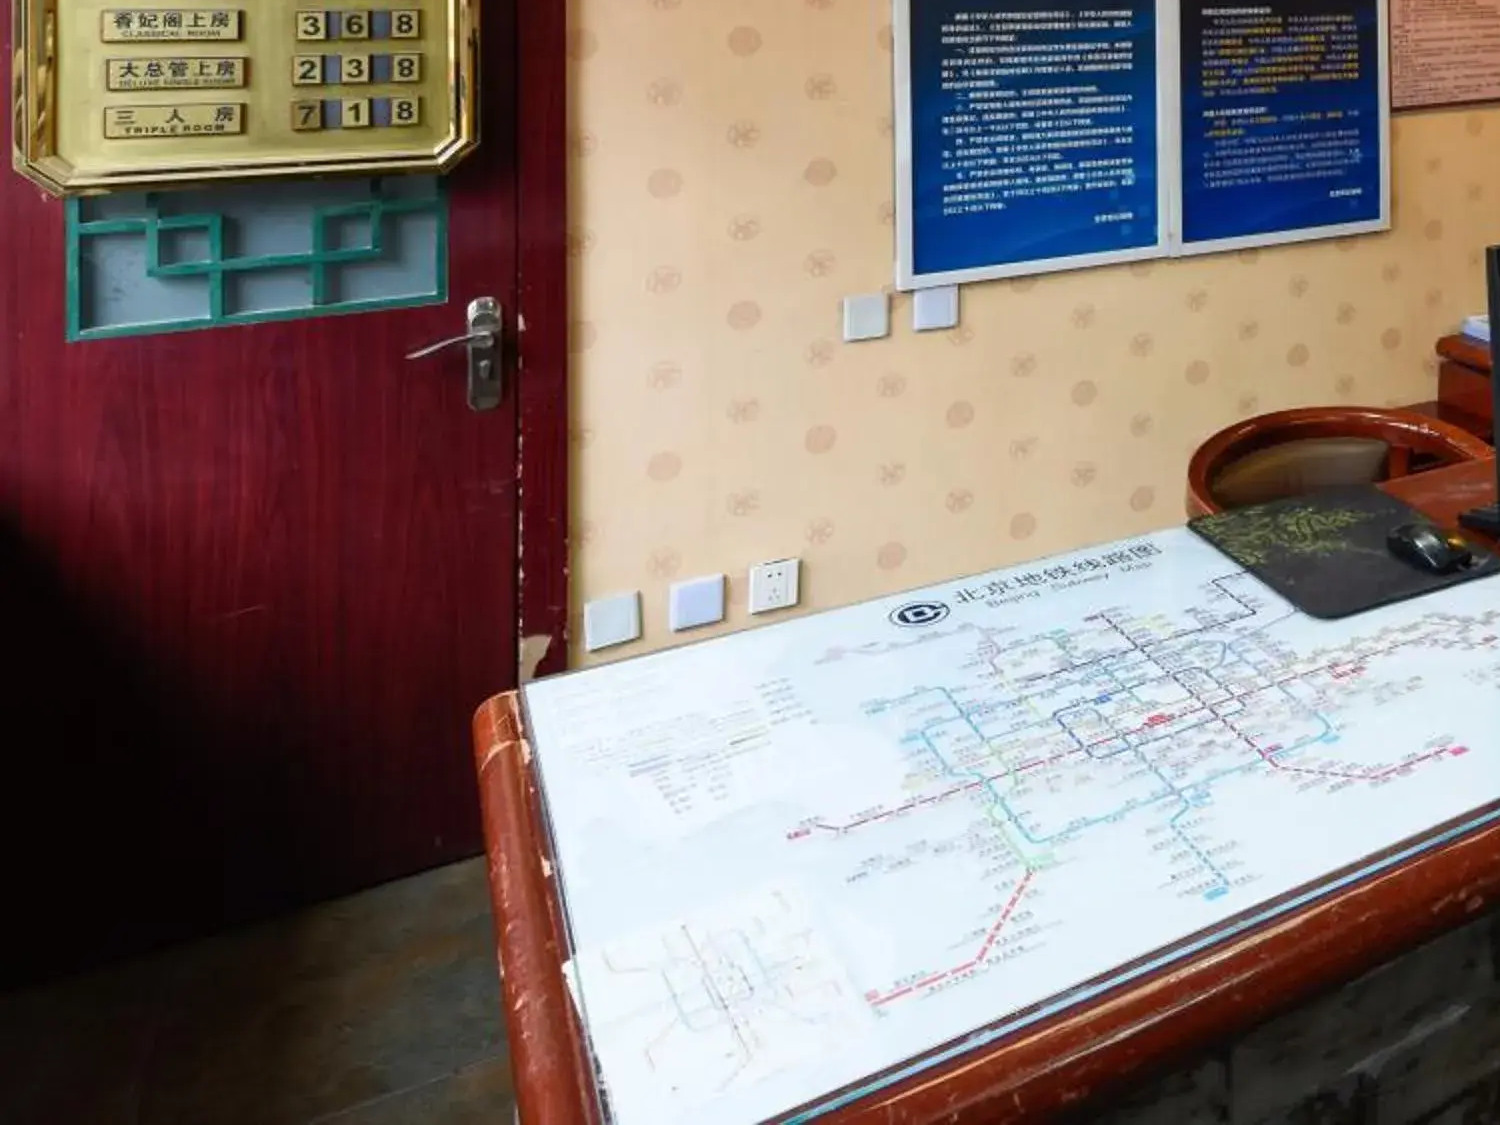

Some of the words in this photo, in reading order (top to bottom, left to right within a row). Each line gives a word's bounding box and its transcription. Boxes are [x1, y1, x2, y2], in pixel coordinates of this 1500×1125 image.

[113, 12, 230, 28] 香妃阁上房
[303, 14, 414, 35] 368
[119, 60, 236, 78] 大总管上房
[298, 58, 414, 80] 238
[115, 106, 235, 124] 三人房
[297, 101, 413, 125] 718
[954, 542, 1163, 604] 北京地铁线路图
